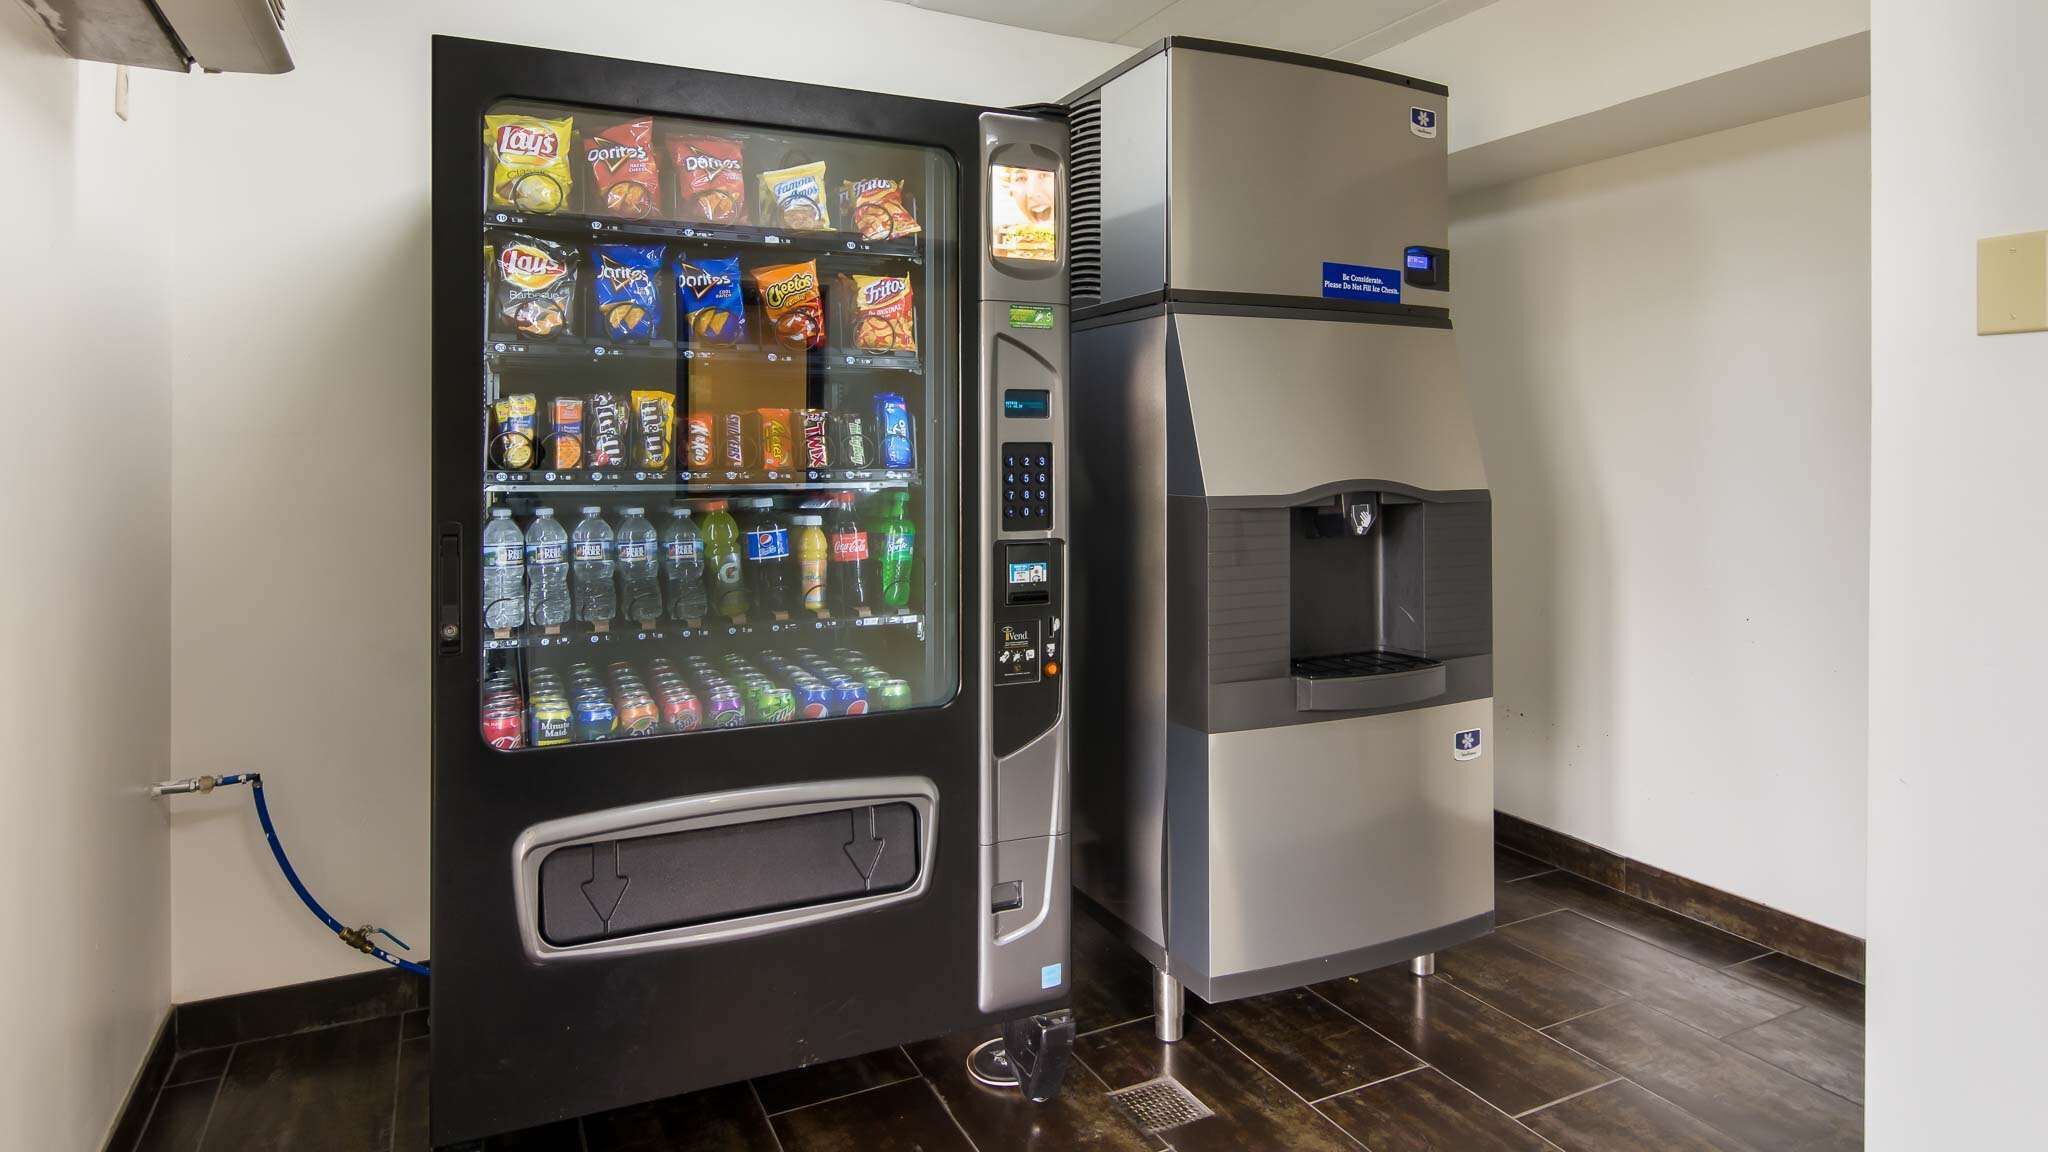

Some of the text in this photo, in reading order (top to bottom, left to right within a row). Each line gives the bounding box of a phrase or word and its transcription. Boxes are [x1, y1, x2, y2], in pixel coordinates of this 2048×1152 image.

[588, 146, 646, 161] Doritos
[686, 156, 741, 171] Doritos
[777, 176, 816, 199] Famous
[854, 179, 891, 198] Fritos
[679, 273, 731, 287] Doritos
[1342, 273, 1350, 281] Be
[767, 273, 813, 308] Cheetos
[865, 280, 905, 304] Fritos
[1324, 280, 1342, 288] Please
[1343, 282, 1351, 290] Do
[1352, 283, 1362, 291] Not
[1363, 284, 1372, 292] Fill
[1372, 285, 1380, 293] Ice
[805, 421, 828, 467] TWIX
[888, 542, 908, 553] Sprite
[541, 722, 570, 730] Minute
[545, 729, 567, 737] Maid
